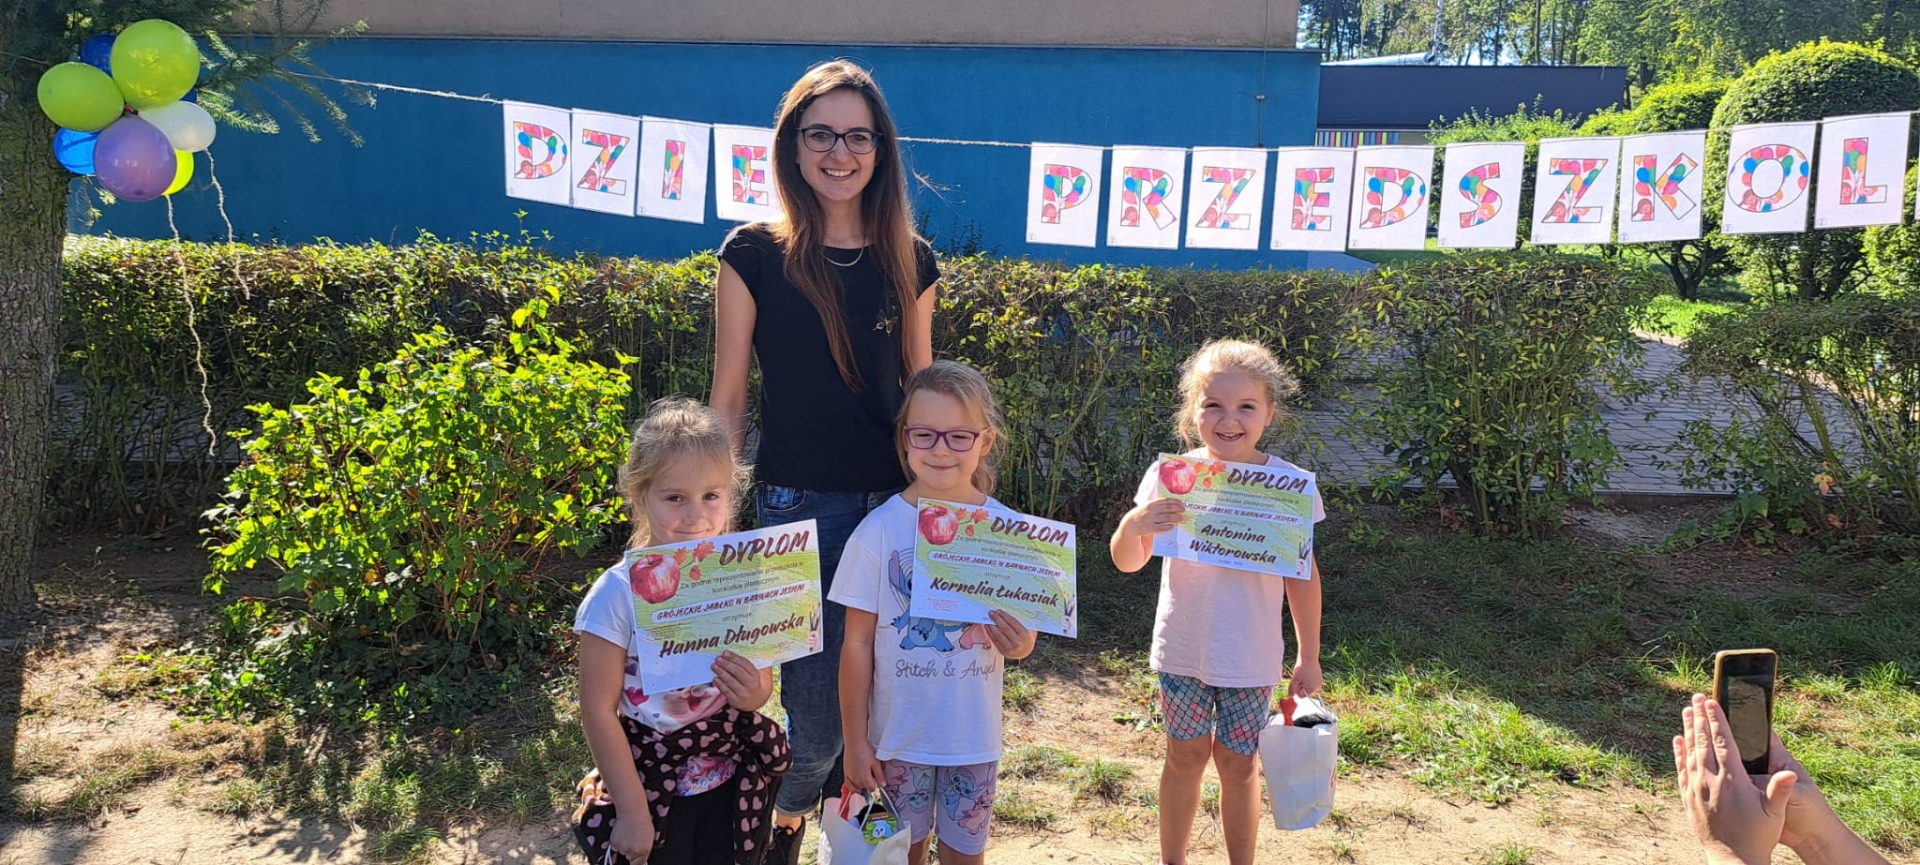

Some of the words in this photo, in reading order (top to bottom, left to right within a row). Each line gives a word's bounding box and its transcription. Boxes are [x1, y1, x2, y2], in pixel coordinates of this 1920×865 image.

[1041, 137, 1896, 232] PRZEDSZKOL
[1227, 468, 1309, 494] DYPLOM
[1184, 503, 1208, 511] JECKIE
[990, 516, 1069, 547] DYPLOM
[1201, 524, 1266, 543] Antonina
[719, 530, 810, 566] DYPLOM
[933, 552, 971, 564] GRÓJECKIE
[971, 557, 997, 567] JABŁKO
[1189, 539, 1277, 565] Wiktorowska
[657, 604, 703, 620] GRÓJECKIE
[703, 599, 734, 612] JABŁKO
[735, 596, 744, 605] W
[743, 590, 779, 604] BARWACH
[779, 583, 805, 596] JESIENI
[930, 577, 993, 597] Kornelia
[995, 582, 1059, 607] Łukasiak
[722, 611, 752, 623] otrzymuje
[659, 635, 720, 658] Hanna
[723, 613, 804, 645] Długowska
[895, 658, 939, 678] Stitch
[943, 660, 956, 677] &
[959, 656, 997, 681] Angel
